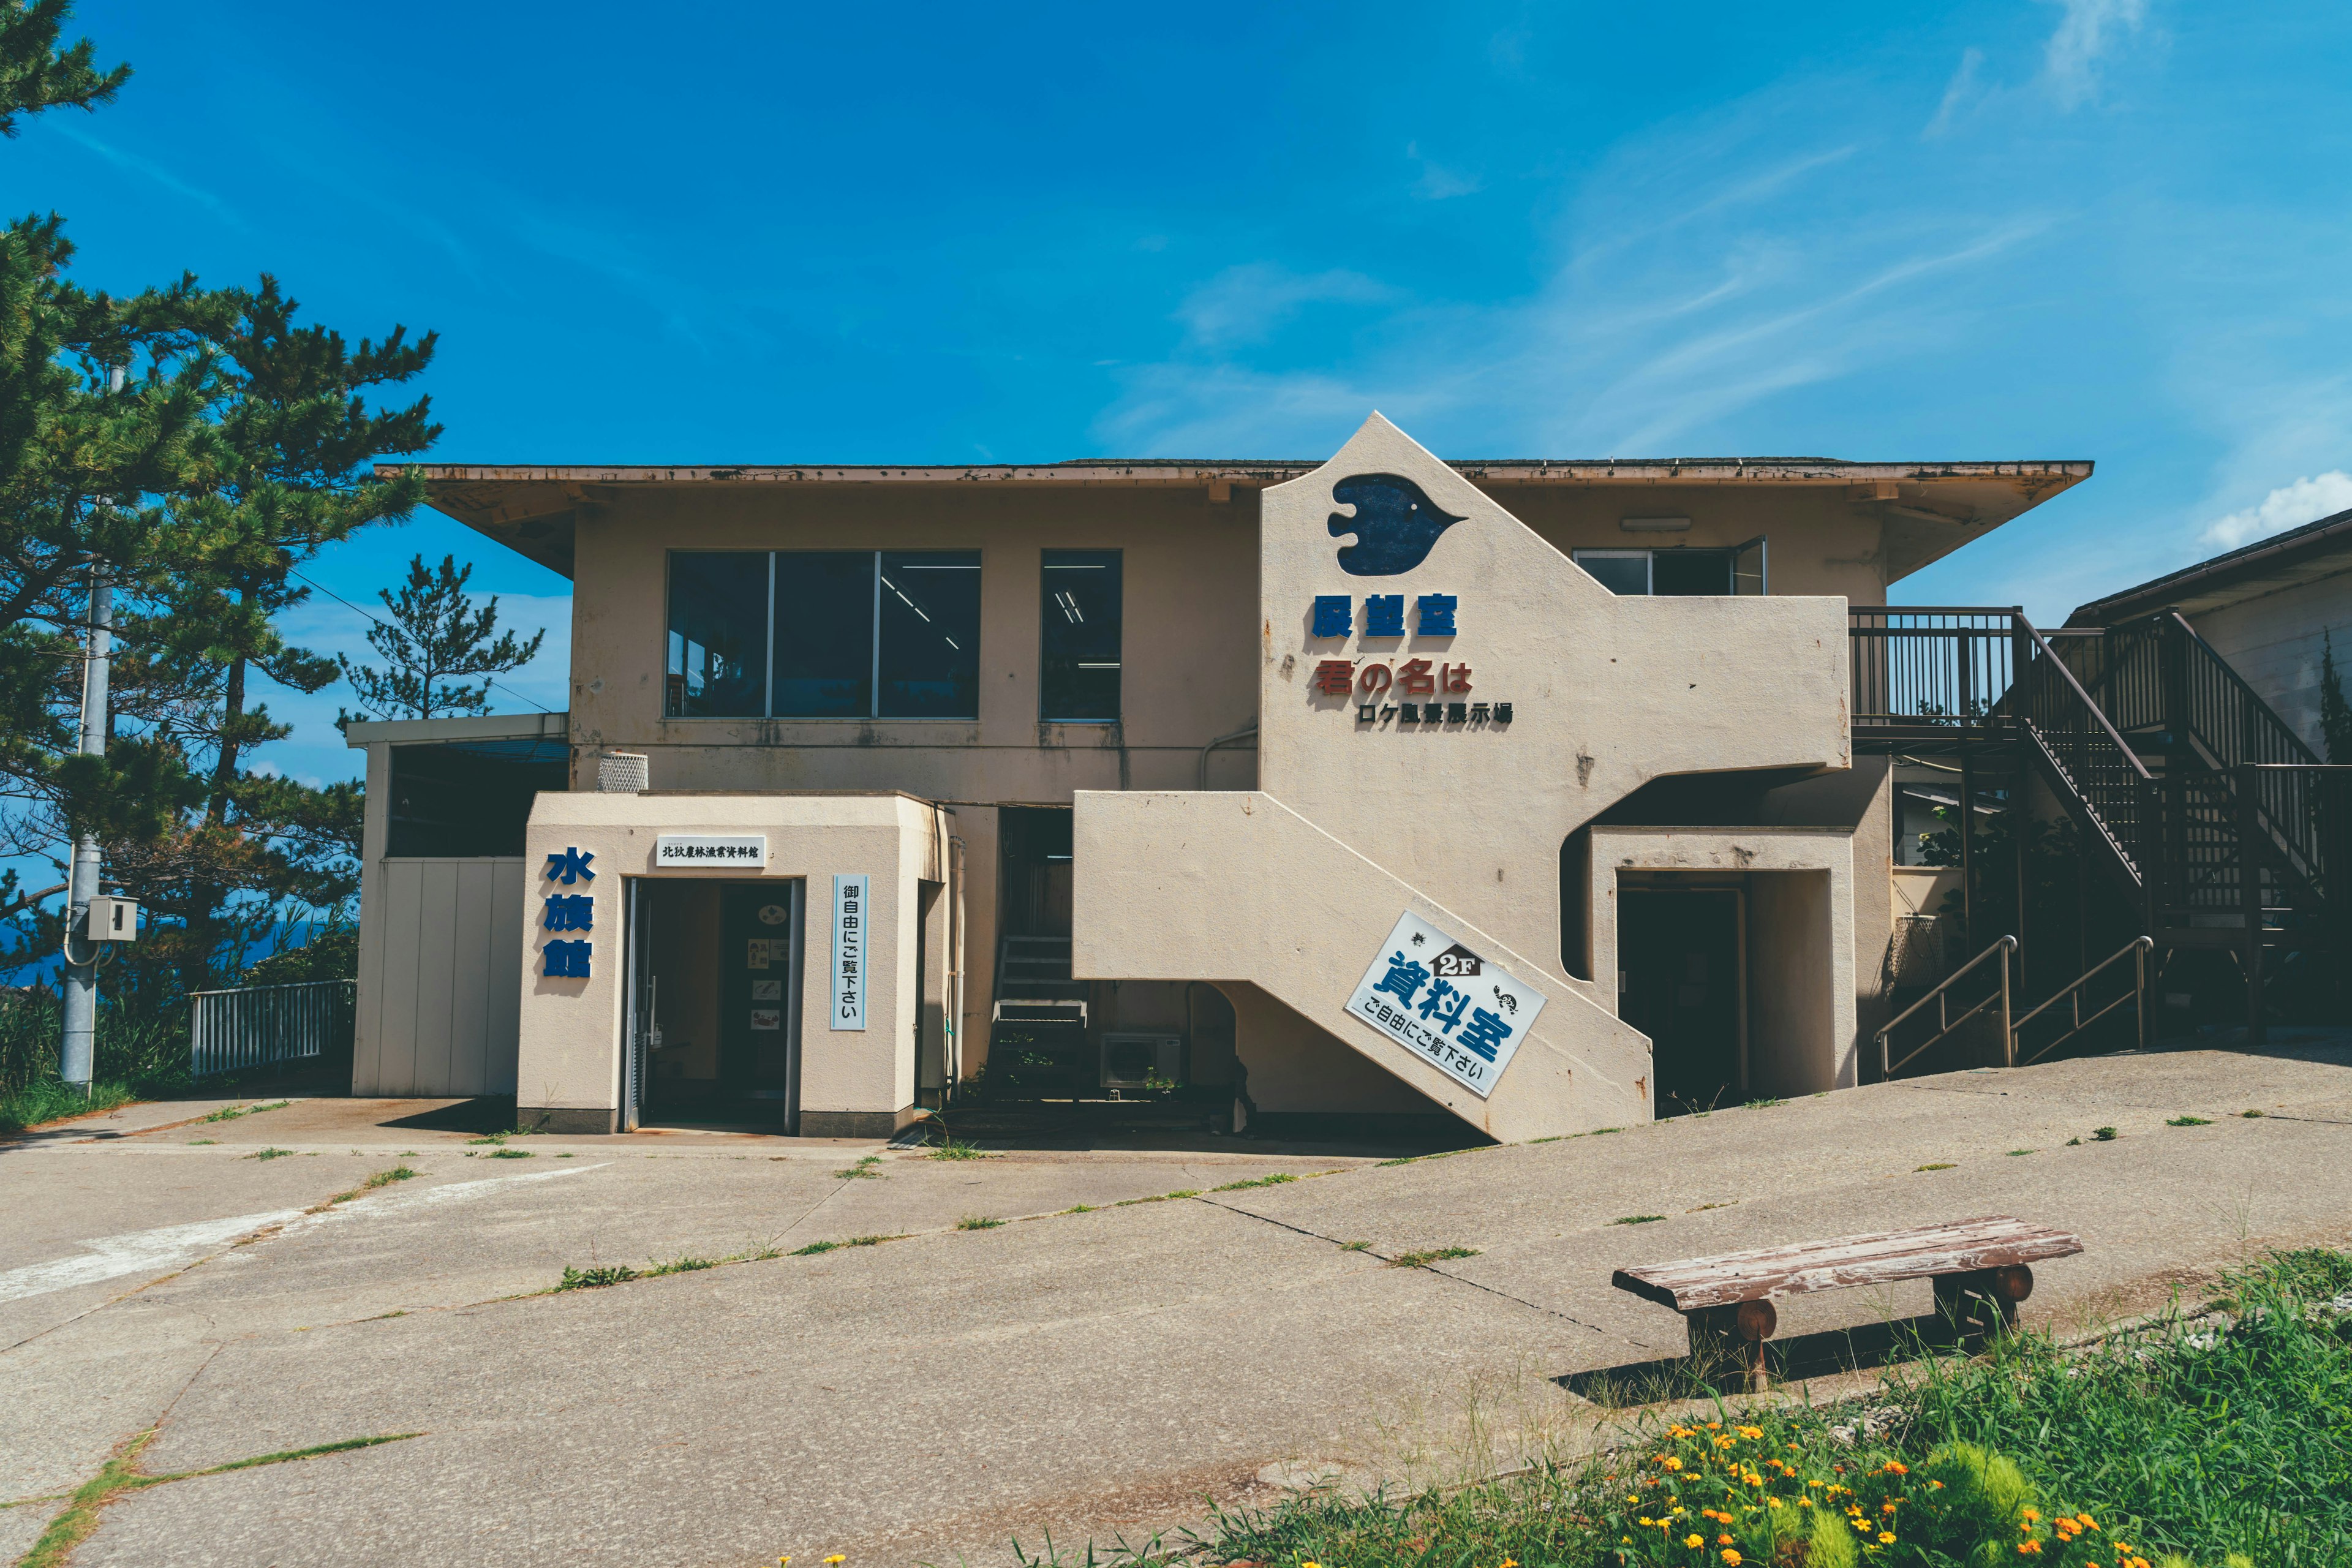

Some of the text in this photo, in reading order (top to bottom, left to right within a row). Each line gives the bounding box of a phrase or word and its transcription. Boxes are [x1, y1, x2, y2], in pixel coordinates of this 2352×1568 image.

[1312, 593, 1457, 638] 展望室
[1316, 658, 1472, 694] 君の名は
[1359, 703, 1513, 723] ロケ風景展示場
[543, 846, 596, 978] 水族館
[842, 885, 859, 1018] 御自由にご覧下さい
[1440, 954, 1475, 975] 2F
[1364, 996, 1483, 1080] ご自由にご覧下さい
[1373, 951, 1513, 1063] 資料室
